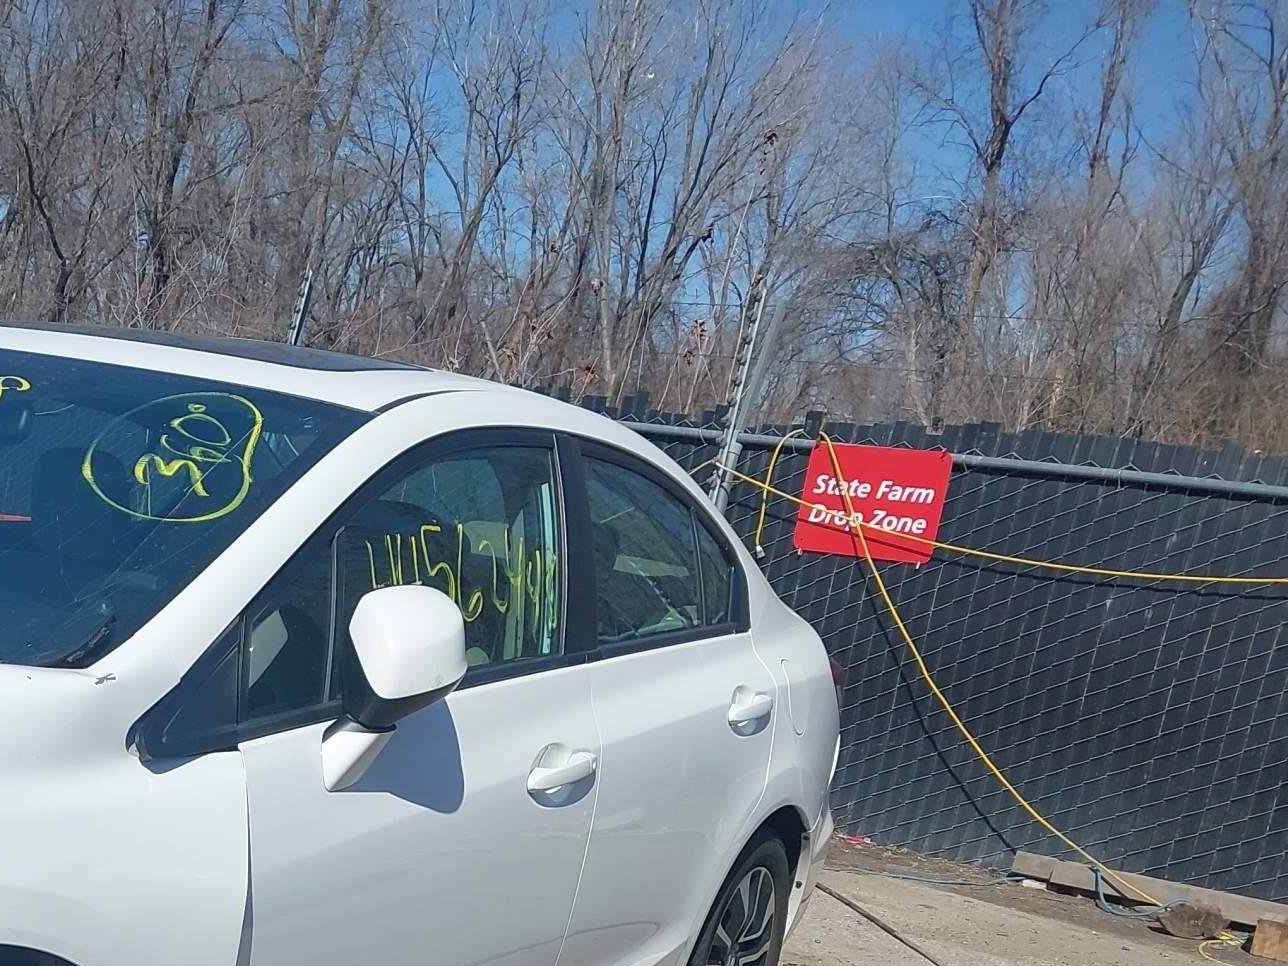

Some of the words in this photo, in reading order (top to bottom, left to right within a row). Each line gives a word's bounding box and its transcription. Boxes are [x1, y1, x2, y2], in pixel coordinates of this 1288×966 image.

[813, 474, 872, 499] State
[875, 480, 936, 504] Farm
[808, 503, 864, 533] Drop
[868, 509, 928, 535] Zone
